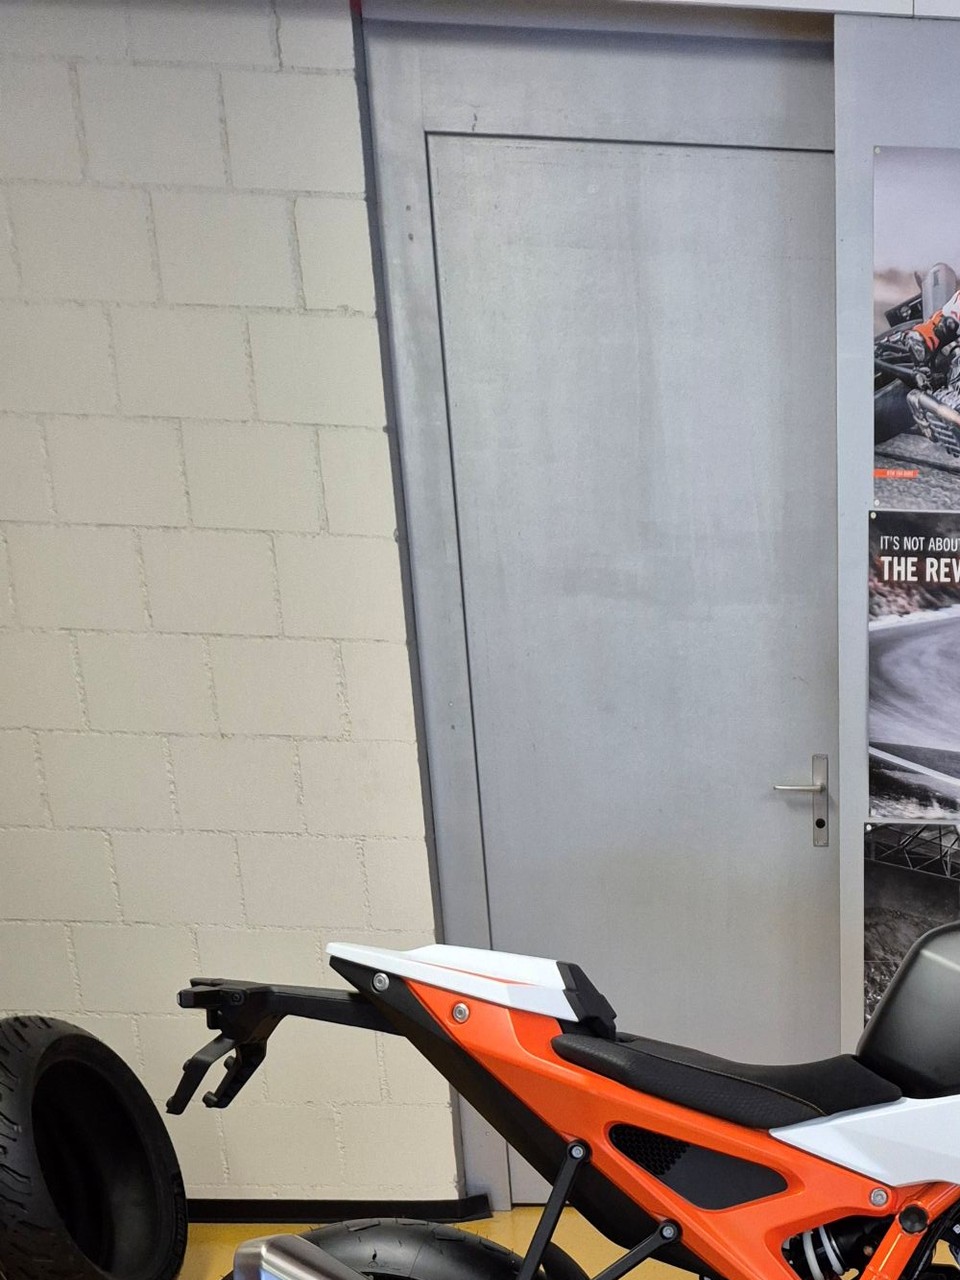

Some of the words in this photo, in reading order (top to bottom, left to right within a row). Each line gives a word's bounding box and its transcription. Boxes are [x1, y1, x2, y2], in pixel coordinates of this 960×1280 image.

[880, 536, 900, 550] IT'S
[903, 536, 925, 551] NOT
[880, 556, 918, 581] THE
